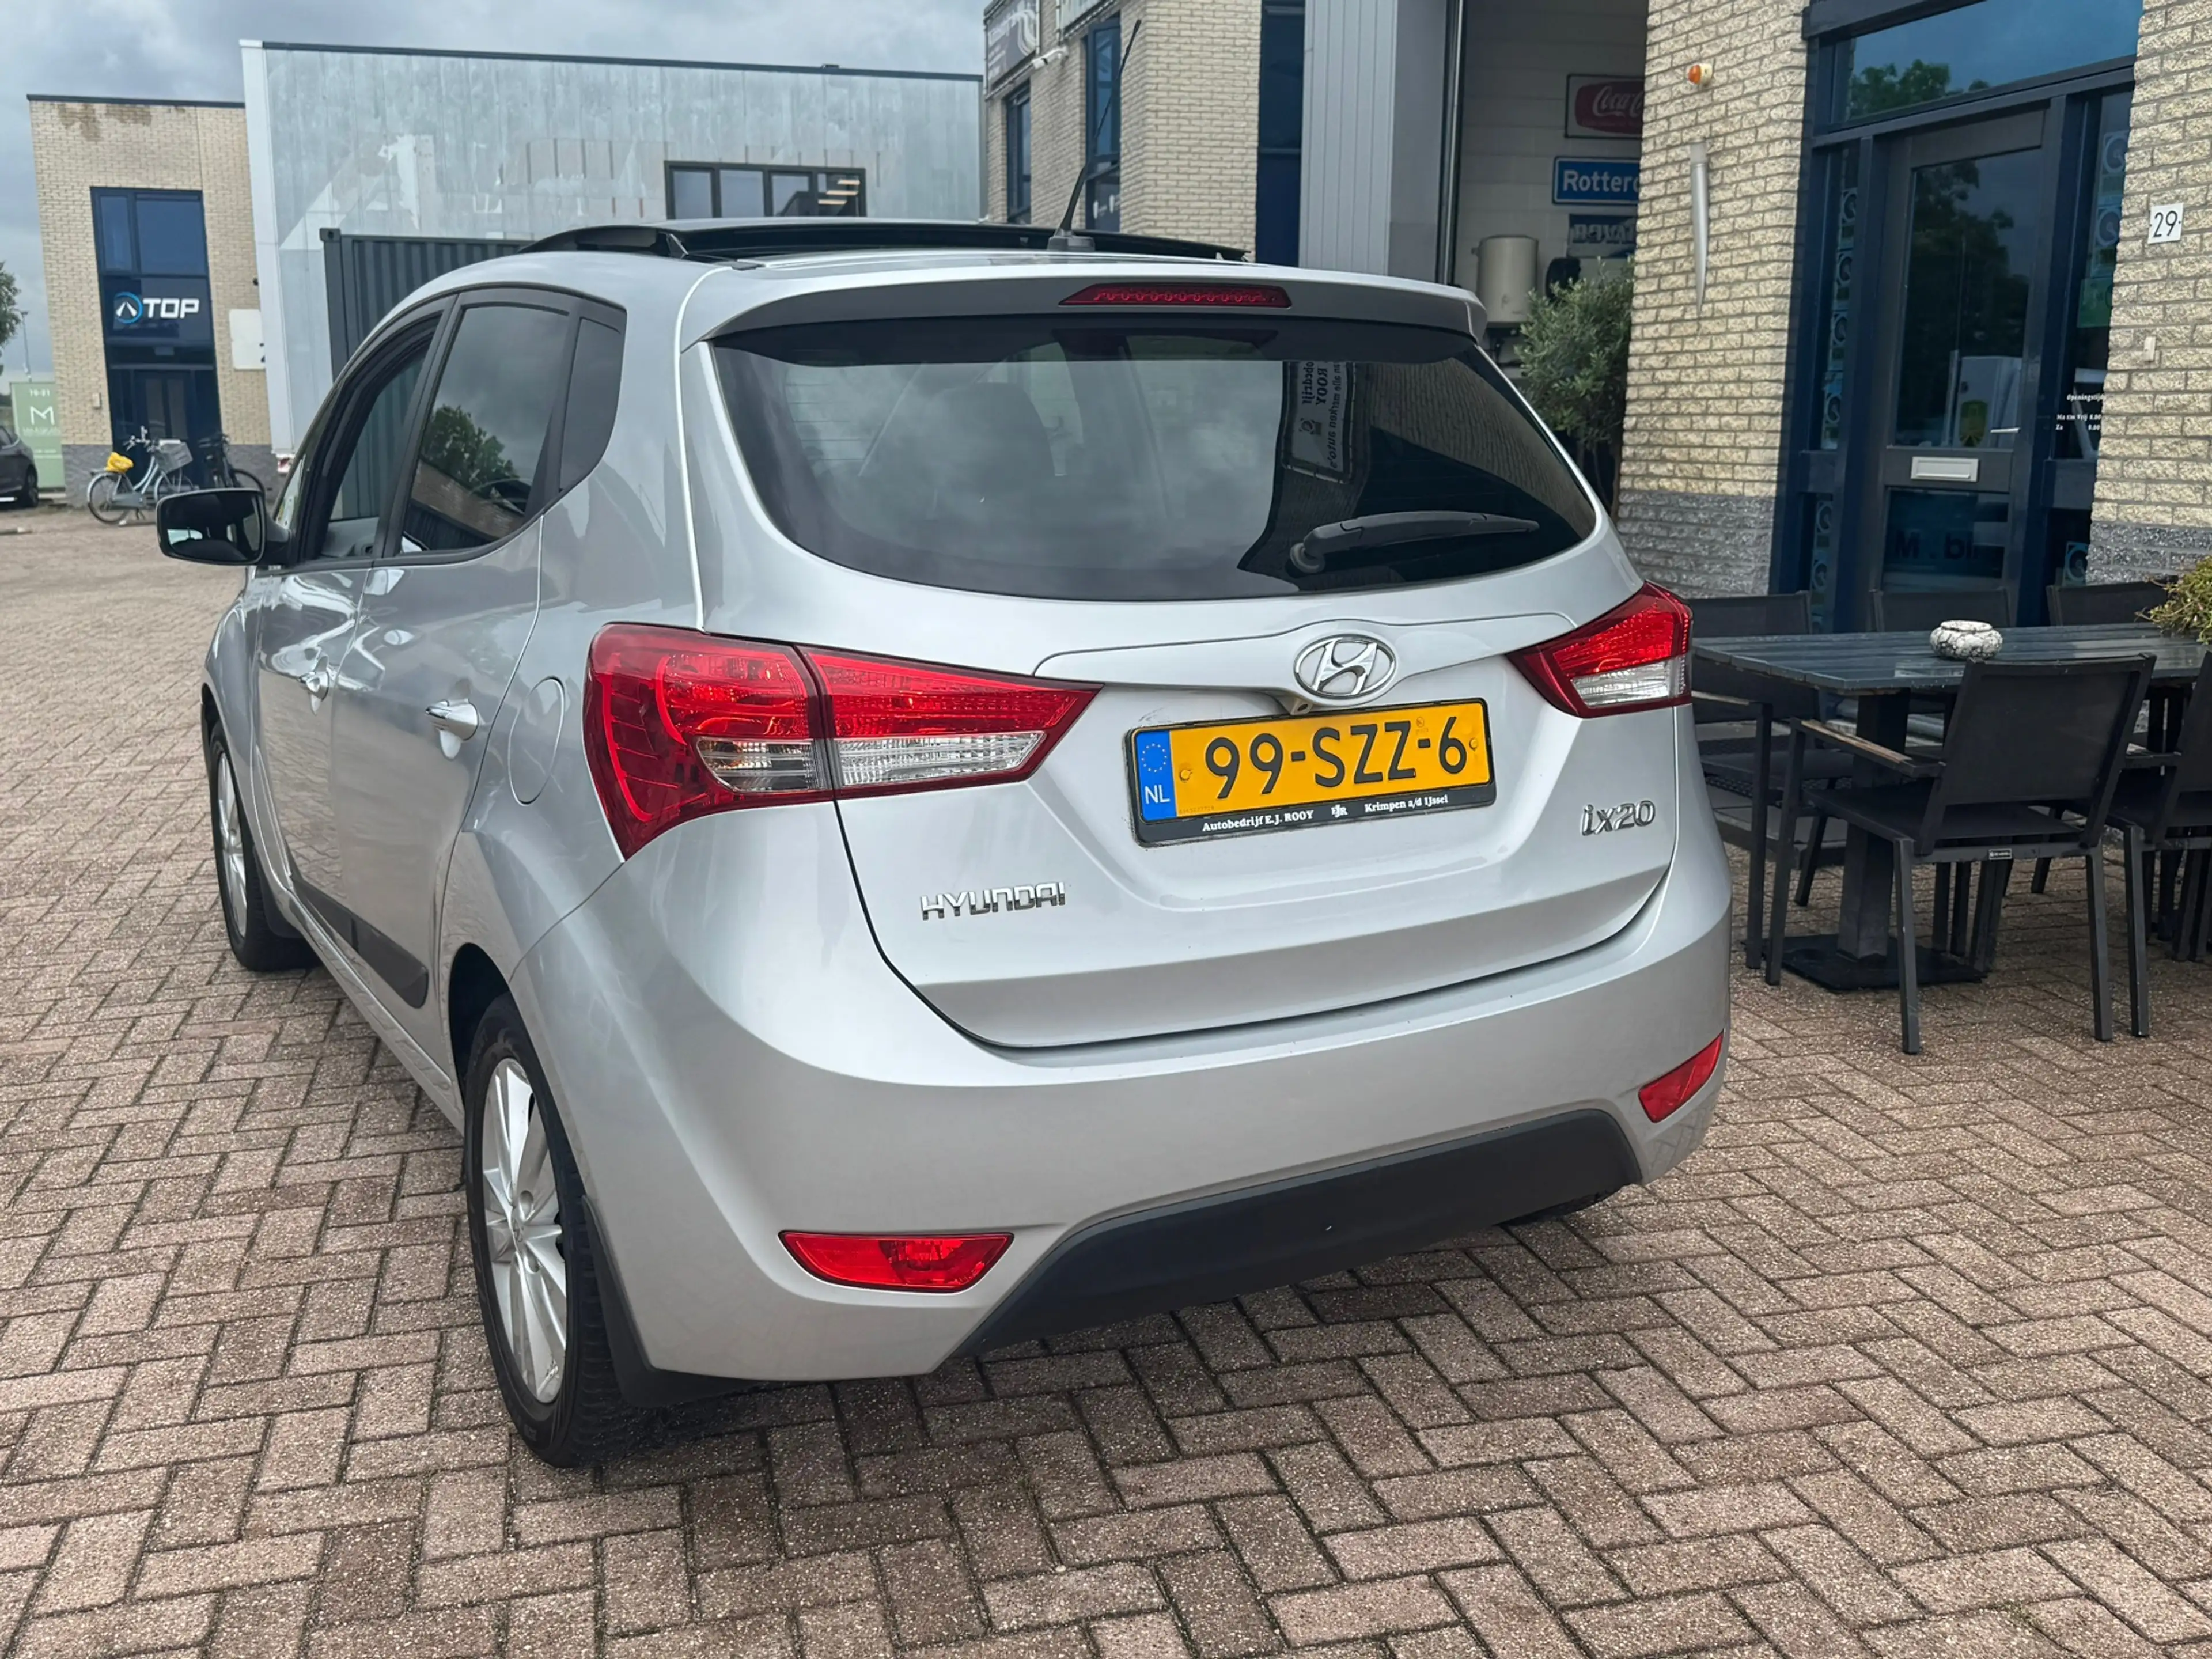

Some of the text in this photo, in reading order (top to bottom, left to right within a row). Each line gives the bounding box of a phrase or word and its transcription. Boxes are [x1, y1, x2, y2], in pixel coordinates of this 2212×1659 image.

[2153, 210, 2178, 238] 29
[142, 297, 200, 319] TOP
[1205, 715, 1468, 800] 99-SZZ-6
[1144, 785, 1171, 805] NL
[1364, 800, 1407, 813] Krimpen
[1407, 797, 1422, 809] a/d
[1202, 810, 1315, 832] Autobedrijf E.J. ROOY
[1581, 800, 1656, 836] ix20
[920, 881, 1066, 921] HYUNDAI
